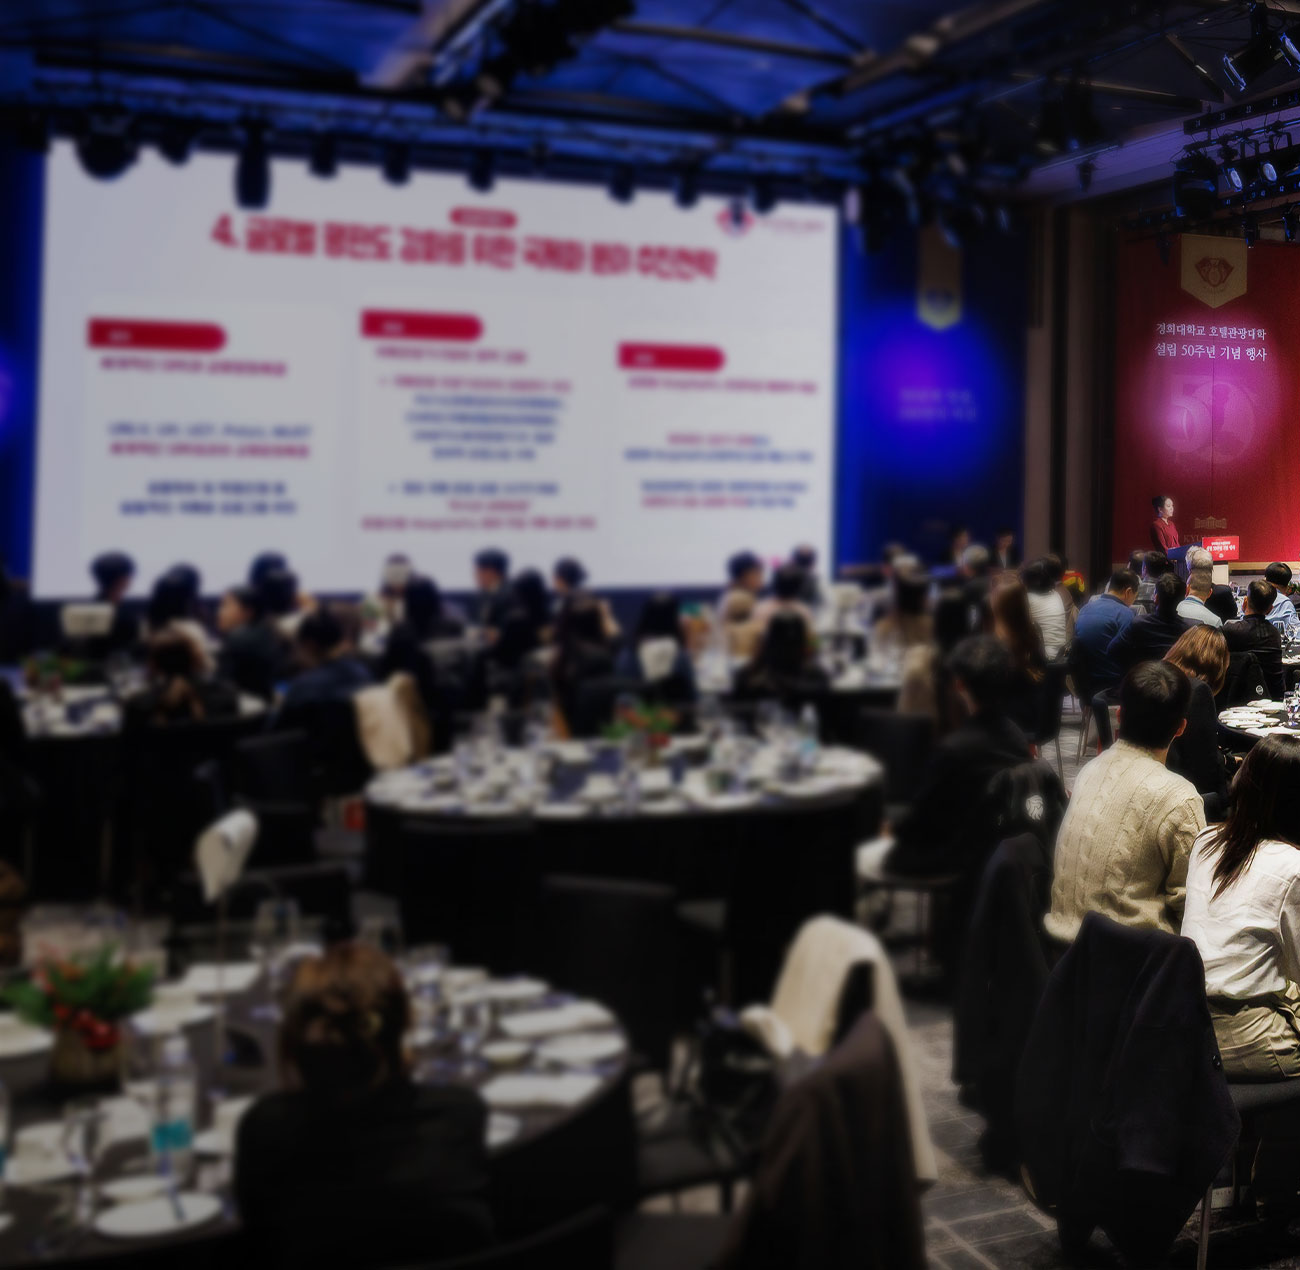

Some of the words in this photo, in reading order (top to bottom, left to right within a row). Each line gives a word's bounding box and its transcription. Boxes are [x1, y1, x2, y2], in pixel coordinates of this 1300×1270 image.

[1157, 322, 1206, 337] 경희대학교
[1208, 326, 1267, 341] 호텔관광대학
[1155, 342, 1177, 357] 설립
[1181, 344, 1216, 359] 50주년
[1220, 346, 1241, 360] 기념
[1245, 347, 1267, 362] 행사
